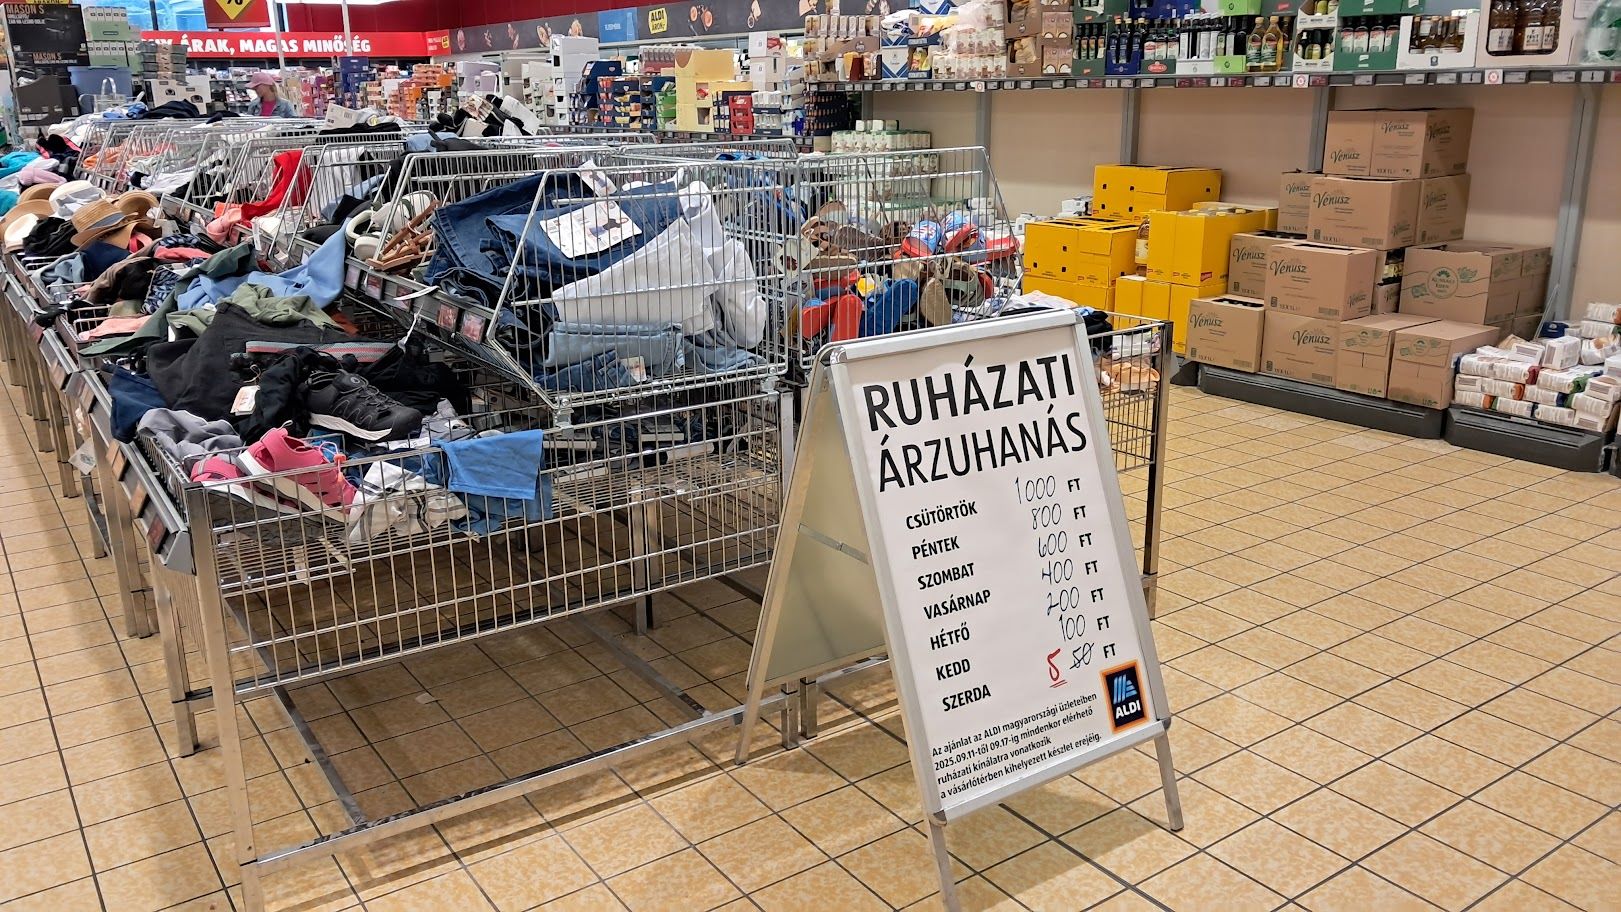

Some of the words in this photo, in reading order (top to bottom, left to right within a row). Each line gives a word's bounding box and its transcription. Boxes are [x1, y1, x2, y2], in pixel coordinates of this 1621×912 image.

[6, 4, 37, 15] MASON
[38, 4, 45, 15] S
[651, 9, 664, 21] ALDI
[33, 52, 56, 61] MASON
[240, 39, 299, 53] MAGAS
[863, 354, 1075, 431] RUHÁZATI
[880, 404, 1087, 492] ÁRZUHANÁS
[906, 500, 978, 529] CSÜTÖRTÖK
[1015, 475, 1056, 504] 1000
[1067, 478, 1081, 493] FT
[912, 536, 960, 559] PÉNTEK
[1031, 503, 1062, 530] 800
[1073, 505, 1086, 520] FT
[917, 562, 975, 590] SZOMBAT
[1038, 531, 1068, 557] 600
[1079, 533, 1092, 547] FT
[923, 589, 991, 619] VASÁRNAP
[1041, 558, 1073, 585] 400
[1085, 560, 1098, 575] FT
[929, 622, 970, 650] HÉTFŐ
[1047, 586, 1080, 616] 200
[1091, 588, 1104, 602] FT
[936, 658, 971, 681] KEDD
[1058, 614, 1086, 642] 100
[1097, 616, 1110, 631] FT
[942, 684, 991, 712] SZERDA
[1103, 643, 1116, 658] FT
[932, 747, 942, 757] Az
[943, 736, 973, 754] ajánlat
[973, 733, 983, 743] az
[984, 725, 1001, 739] ALDI
[1002, 704, 1059, 732] magyarországi
[1059, 693, 1097, 712] üzleteiben
[934, 743, 989, 771] 2025.09.11-től
[990, 734, 1020, 751] 09.17-ig
[1020, 719, 1061, 740] mindenkor
[1062, 706, 1093, 725] elérhető
[1115, 700, 1141, 719] ALDI
[937, 765, 972, 785] ruházati
[972, 753, 1009, 772] kínálatra
[1009, 736, 1052, 758] vonatkozik
[940, 791, 946, 799] a
[947, 768, 1004, 796] vásárlótérben
[1004, 751, 1047, 776] kihelyezett
[1047, 742, 1074, 758] készlet
[1074, 732, 1102, 748] erejéig.
